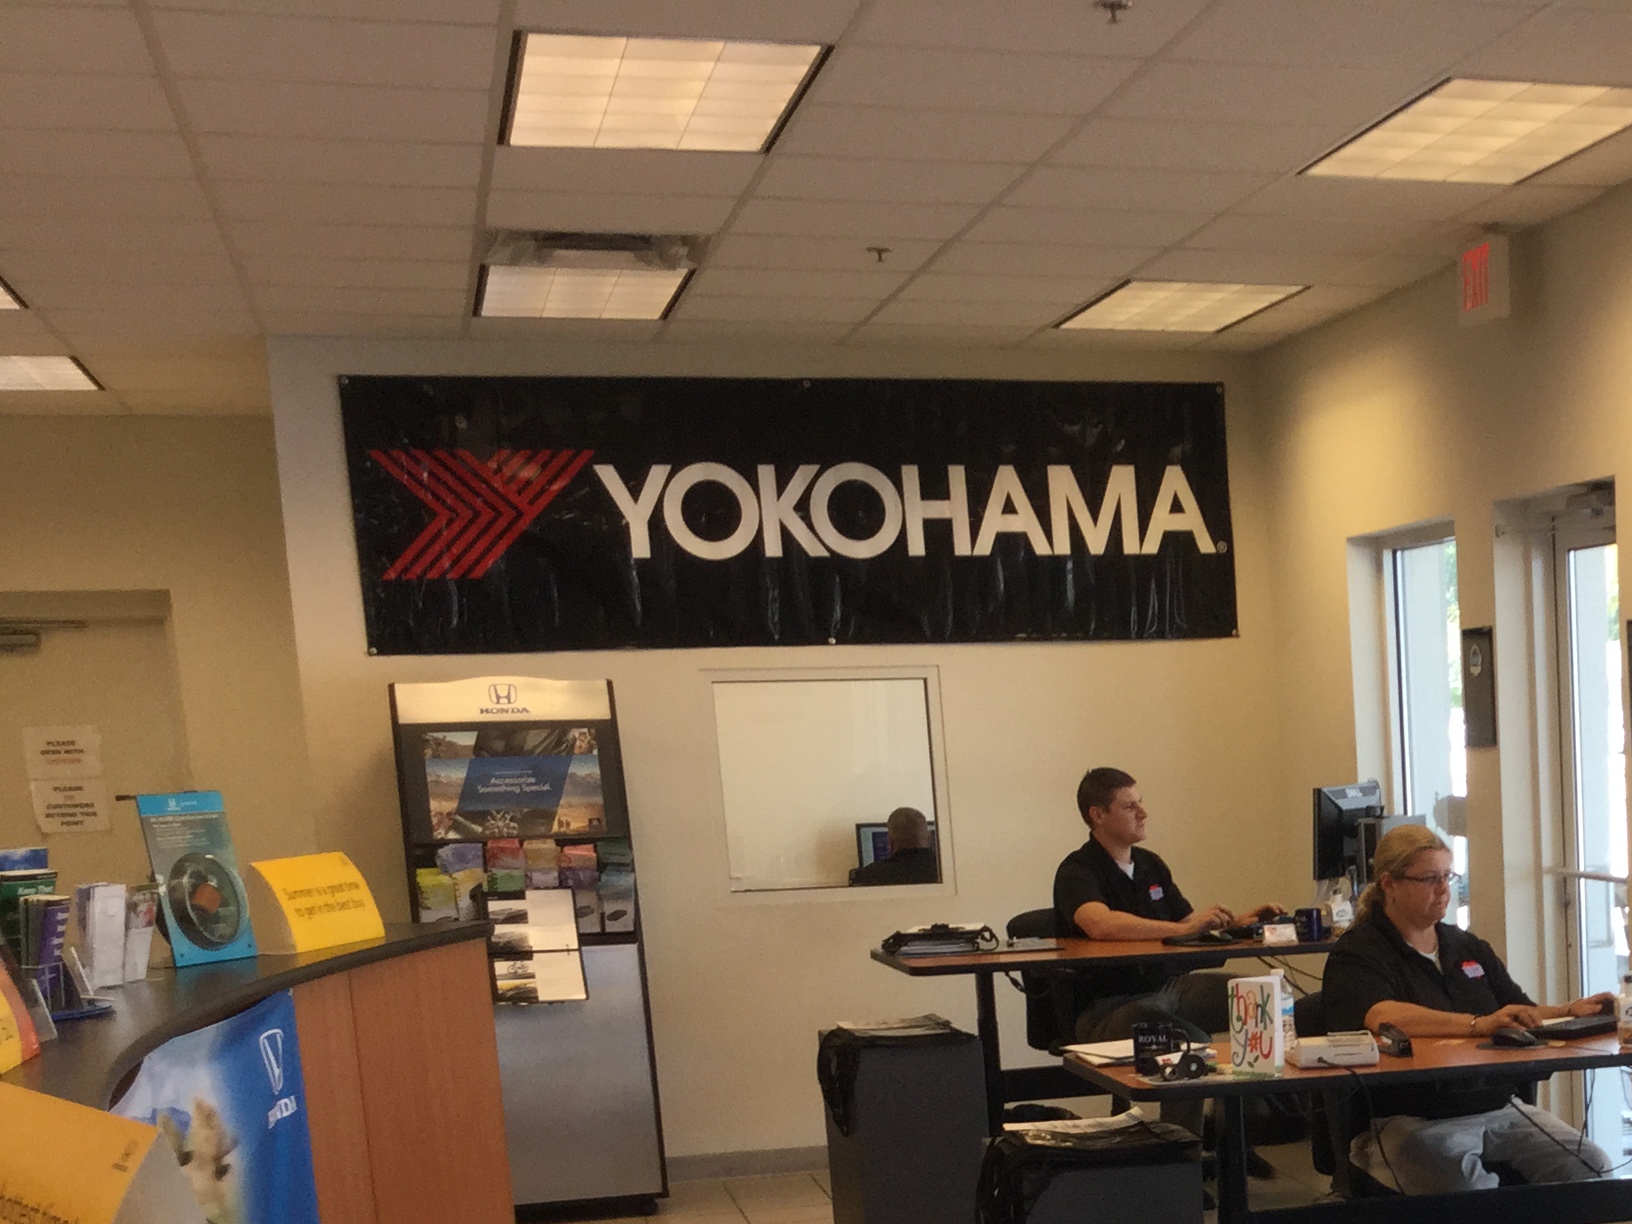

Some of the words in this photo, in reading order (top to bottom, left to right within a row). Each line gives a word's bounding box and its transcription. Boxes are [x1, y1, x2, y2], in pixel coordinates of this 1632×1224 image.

[1462, 242, 1490, 312] EXIT
[593, 461, 1218, 561] YOKOHAMA
[1228, 983, 1274, 1034] thank
[1137, 1034, 1169, 1044] ROYAL
